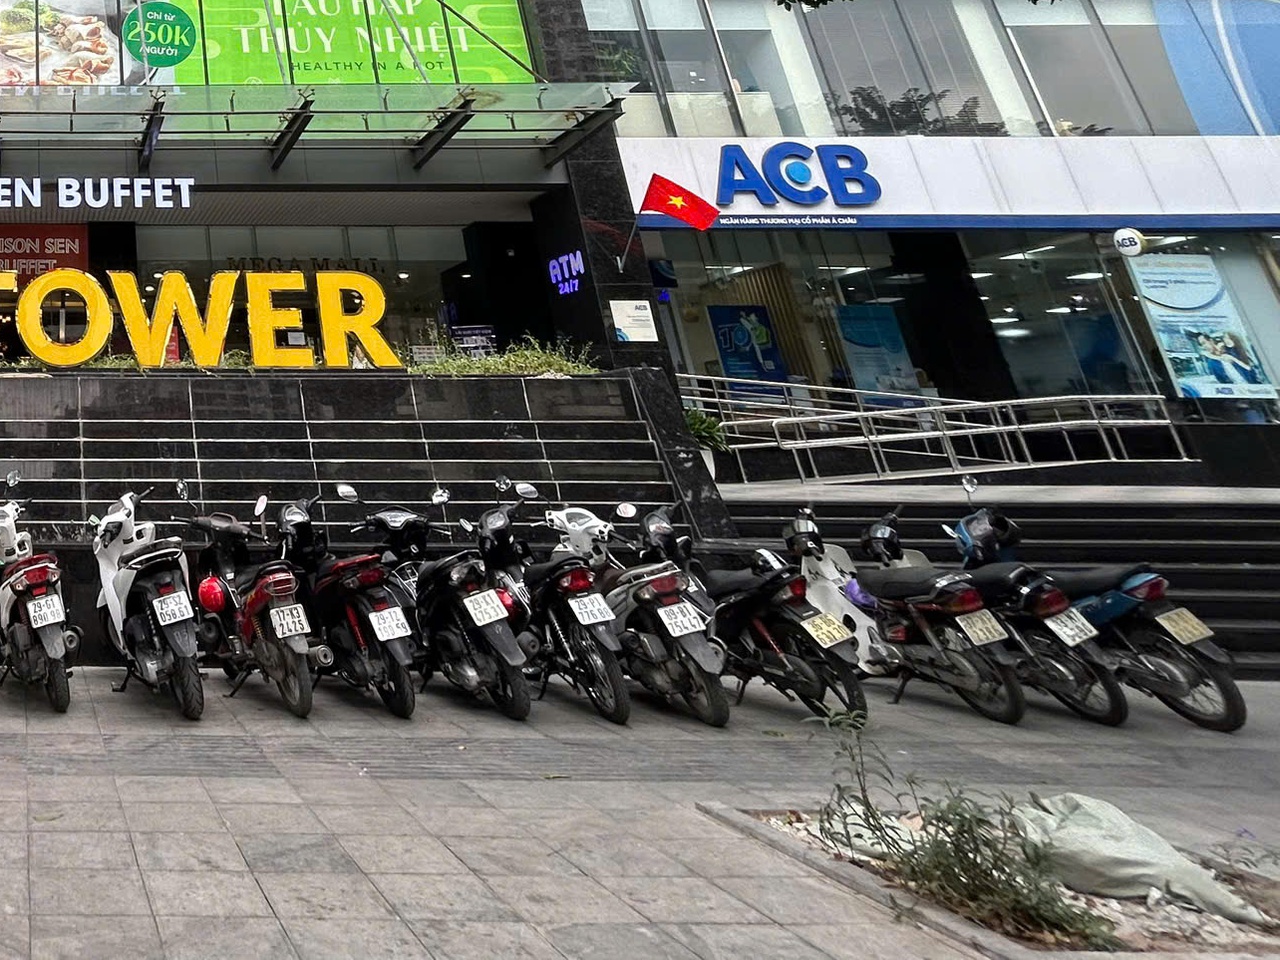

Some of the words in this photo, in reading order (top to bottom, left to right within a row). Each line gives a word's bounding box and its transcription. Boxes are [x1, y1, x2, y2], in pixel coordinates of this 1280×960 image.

[127, 20, 191, 47] 250K
[291, 61, 364, 71] HEALTHY
[396, 62, 405, 70] A
[715, 141, 882, 206] ACB
[57, 177, 195, 209] BUFFET
[44, 238, 80, 254] SEN
[1116, 236, 1138, 250] ACB
[548, 250, 585, 284] ATM
[276, 606, 301, 622] 17-K3
[279, 619, 305, 637] 2425
